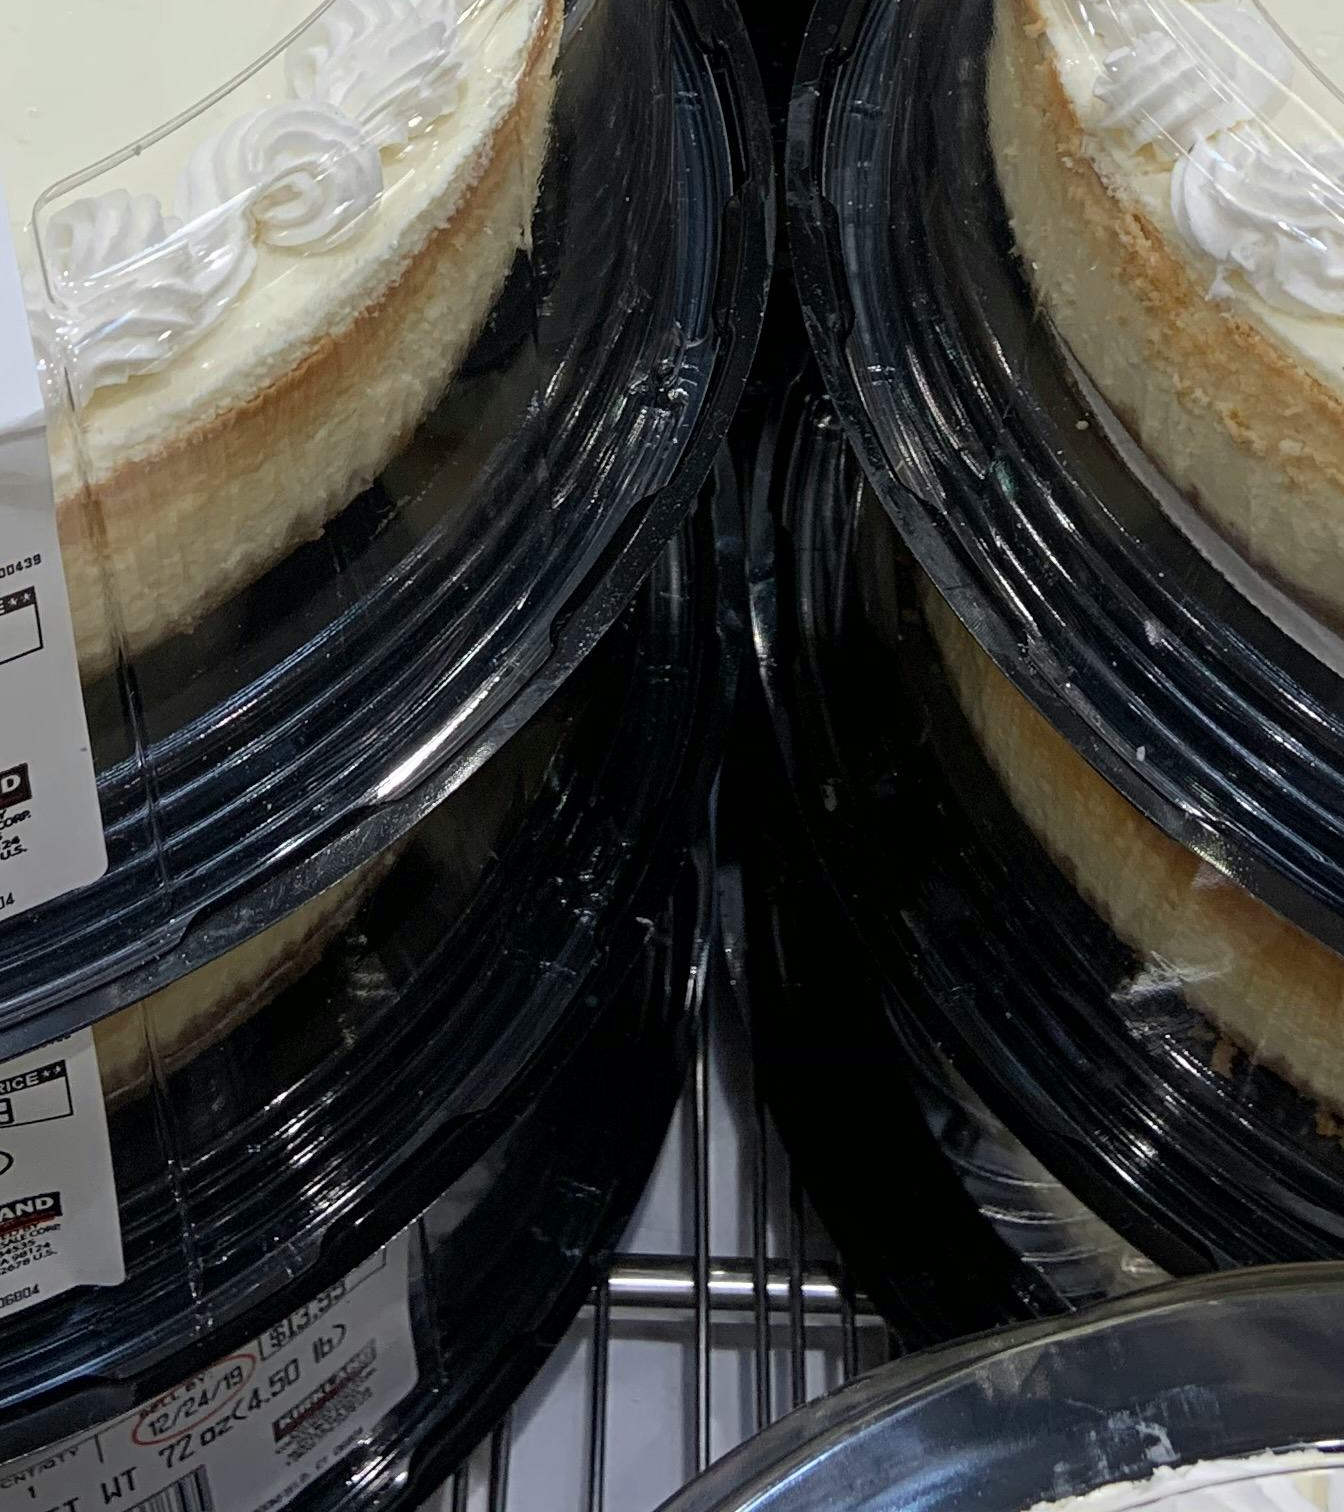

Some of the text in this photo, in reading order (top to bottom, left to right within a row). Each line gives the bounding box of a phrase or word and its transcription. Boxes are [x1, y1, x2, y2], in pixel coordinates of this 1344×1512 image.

[149, 1365, 244, 1437] 12/24/19
[100, 1467, 138, 1504] WT
[157, 1434, 195, 1470] 72
